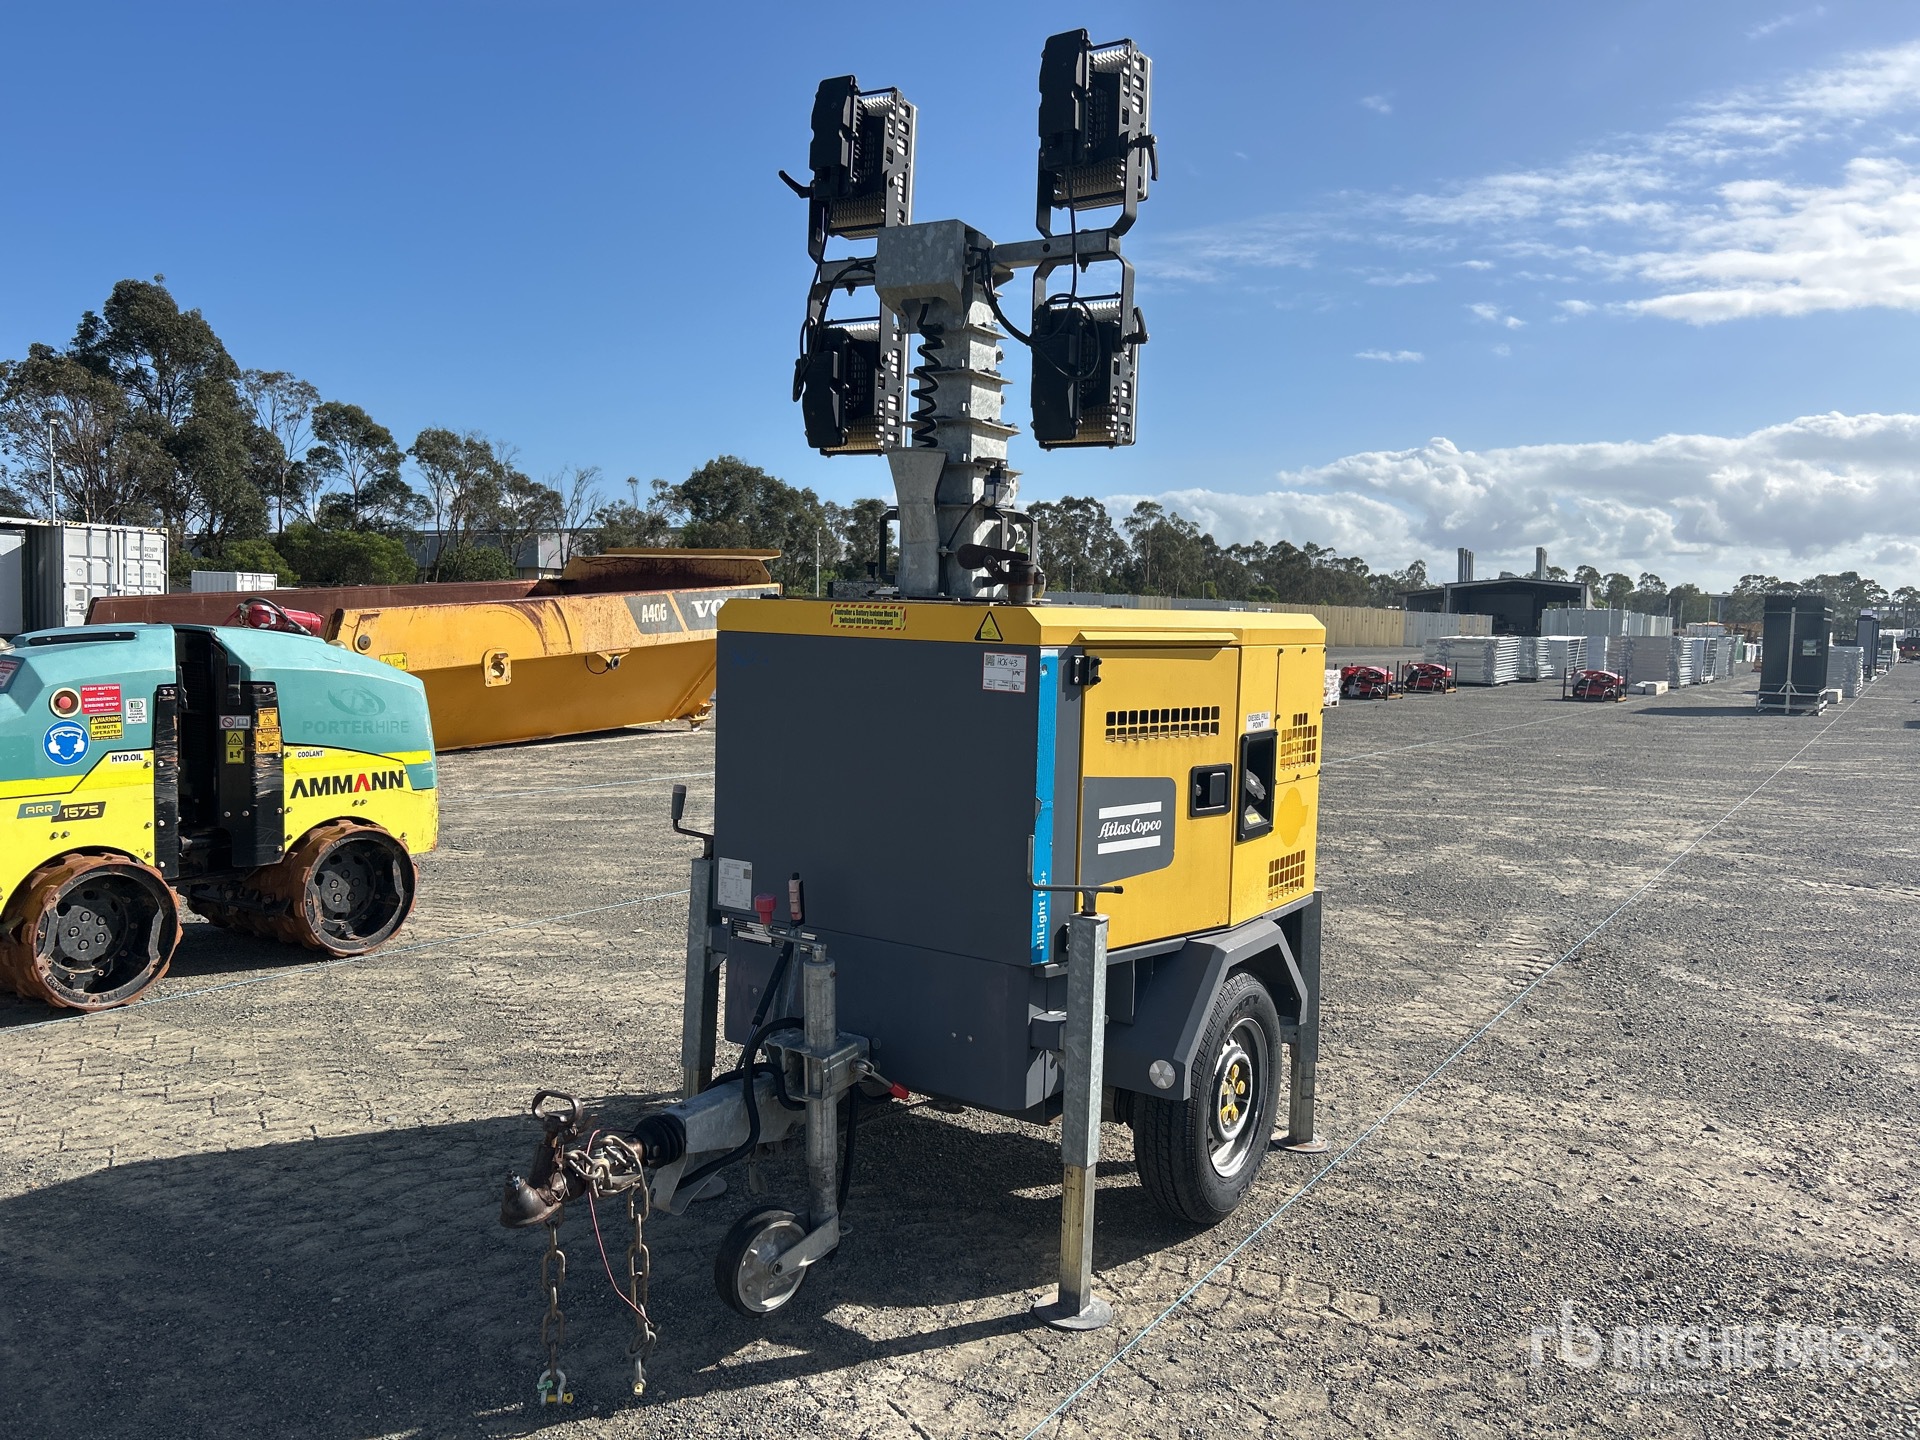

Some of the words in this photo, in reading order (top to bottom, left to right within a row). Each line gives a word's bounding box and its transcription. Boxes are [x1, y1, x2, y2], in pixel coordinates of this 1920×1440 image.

[641, 603, 667, 623] A40G
[856, 609, 869, 617] Battery
[1248, 713, 1260, 722] DIESEL
[1261, 712, 1269, 720] FILL
[111, 753, 143, 762] HYD.OIL
[289, 770, 404, 799] AMMANN
[25, 804, 54, 814] ARR
[62, 805, 99, 818] 1575
[1097, 821, 1131, 839] Atlas
[1131, 818, 1162, 835] Copco
[1036, 900, 1047, 950] HiLight
